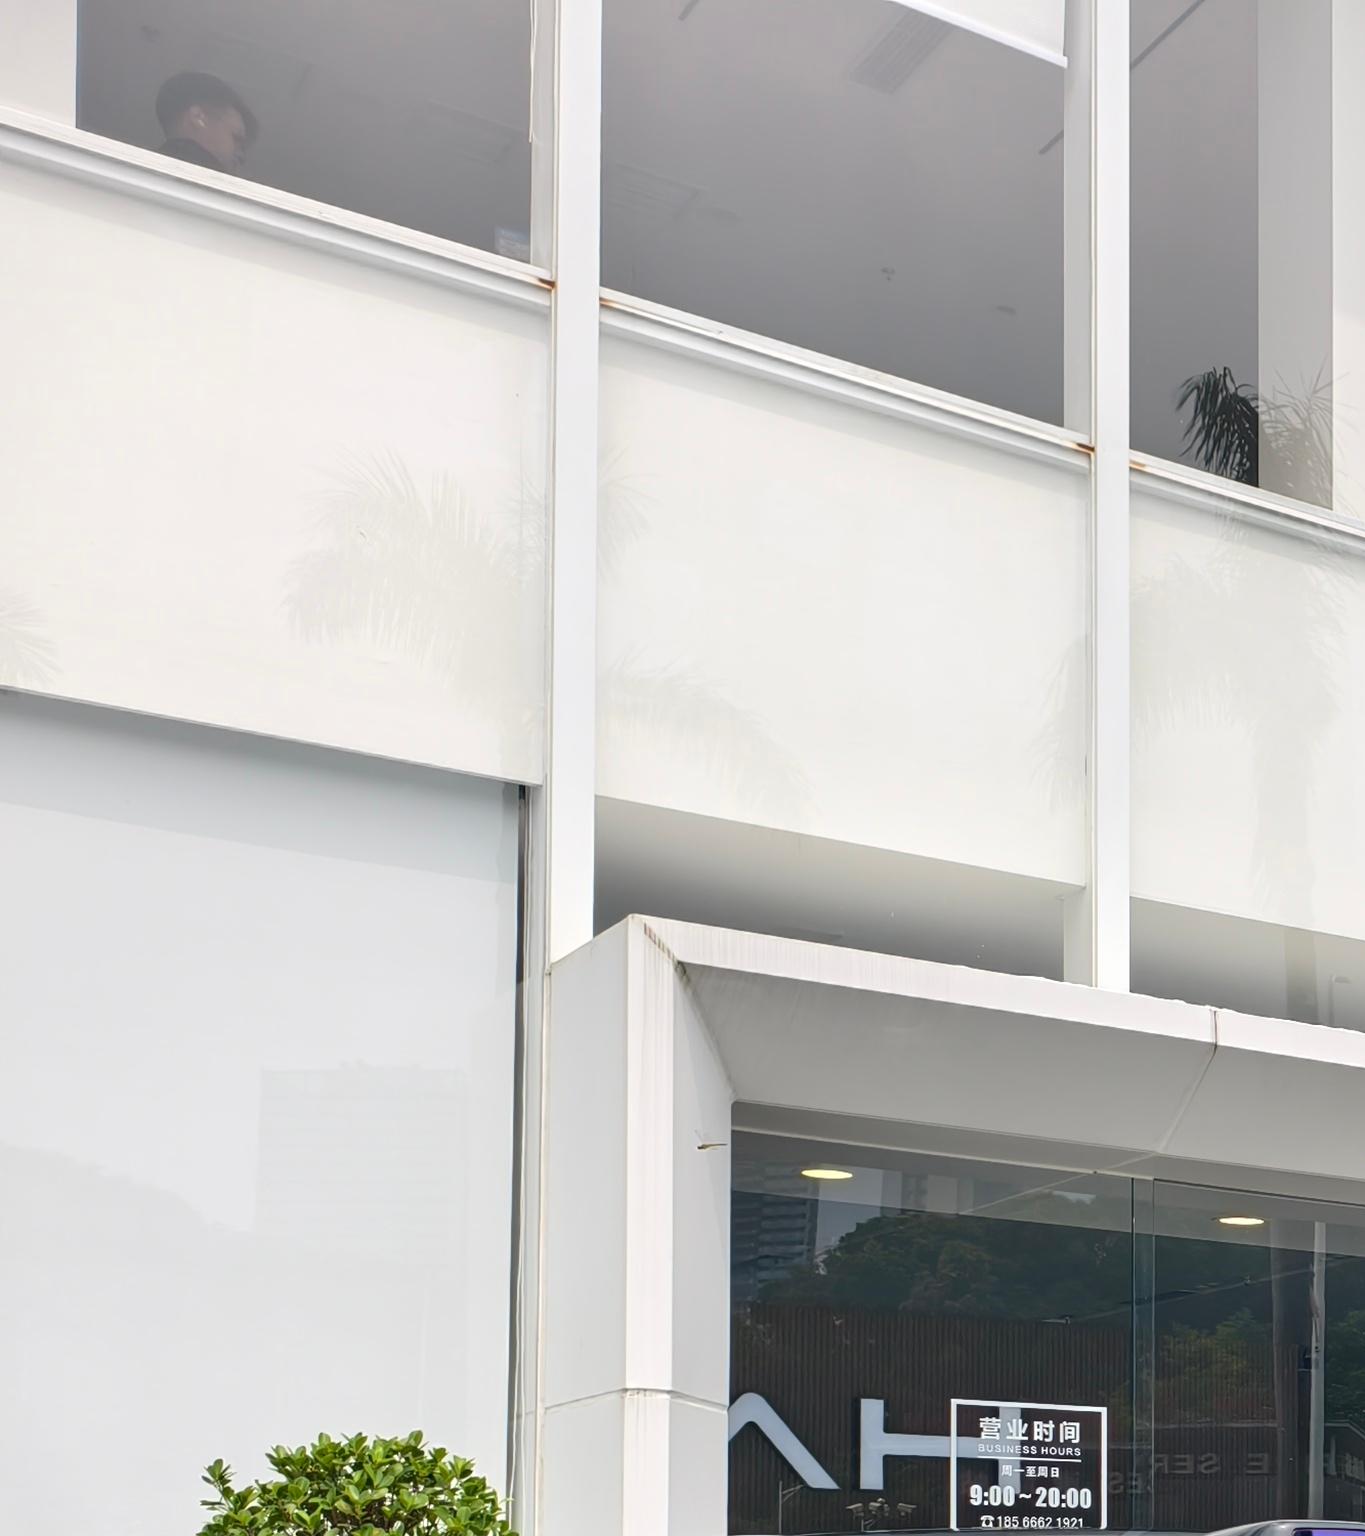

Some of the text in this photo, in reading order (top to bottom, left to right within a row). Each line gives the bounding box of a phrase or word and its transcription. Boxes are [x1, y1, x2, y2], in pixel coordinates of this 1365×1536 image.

[979, 1417, 1081, 1443] 营业时间
[978, 1444, 1081, 1456] BUSINESS HOURS
[1002, 1465, 1060, 1478] 周一至周日
[997, 1515, 1083, 1528] 185 6662 1921
